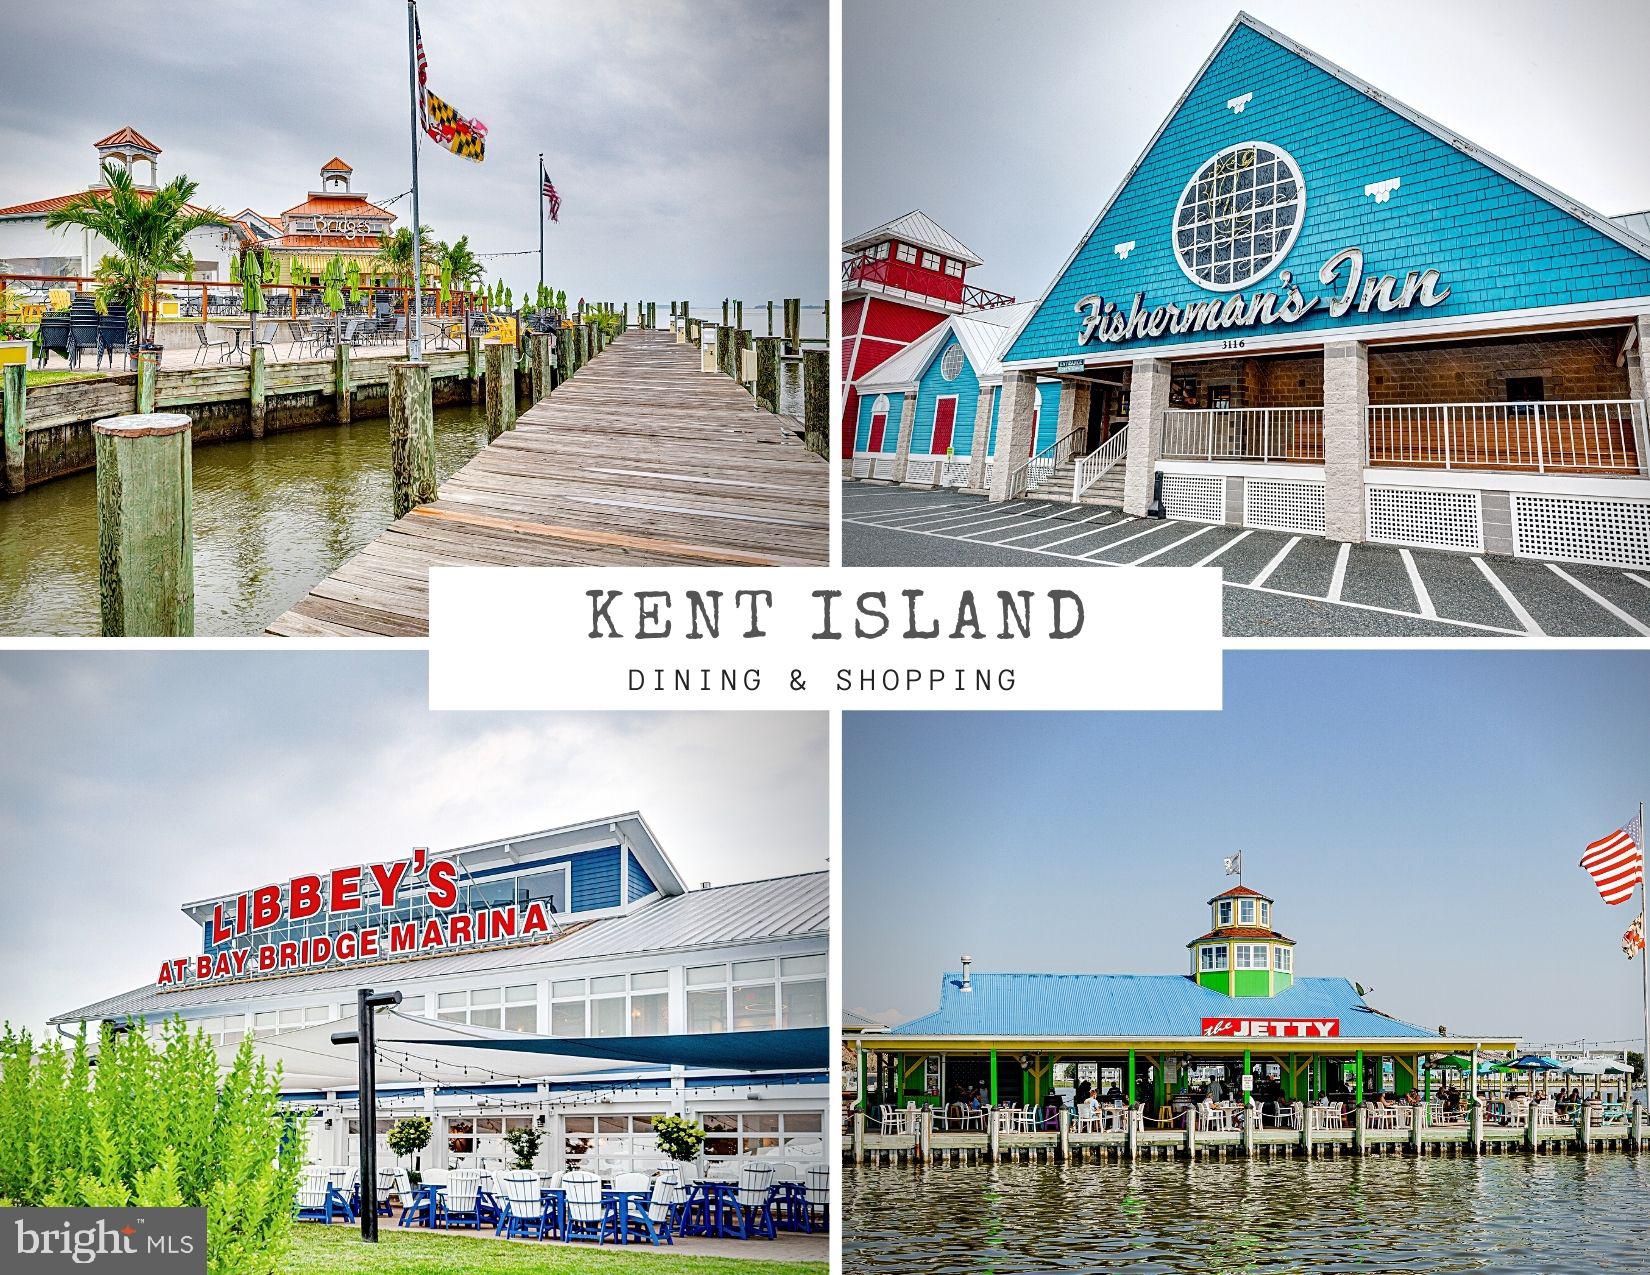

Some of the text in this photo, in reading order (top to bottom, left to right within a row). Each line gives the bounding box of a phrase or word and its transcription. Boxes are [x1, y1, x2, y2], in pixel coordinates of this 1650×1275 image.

[1074, 247, 1451, 347] Fisherman's Inn
[1221, 340, 1246, 350] 3116
[212, 848, 460, 946] LIBBEY'S
[156, 901, 552, 987] AT BAY BRIDGE MARINA
[1203, 1020, 1336, 1037] the JETTY
